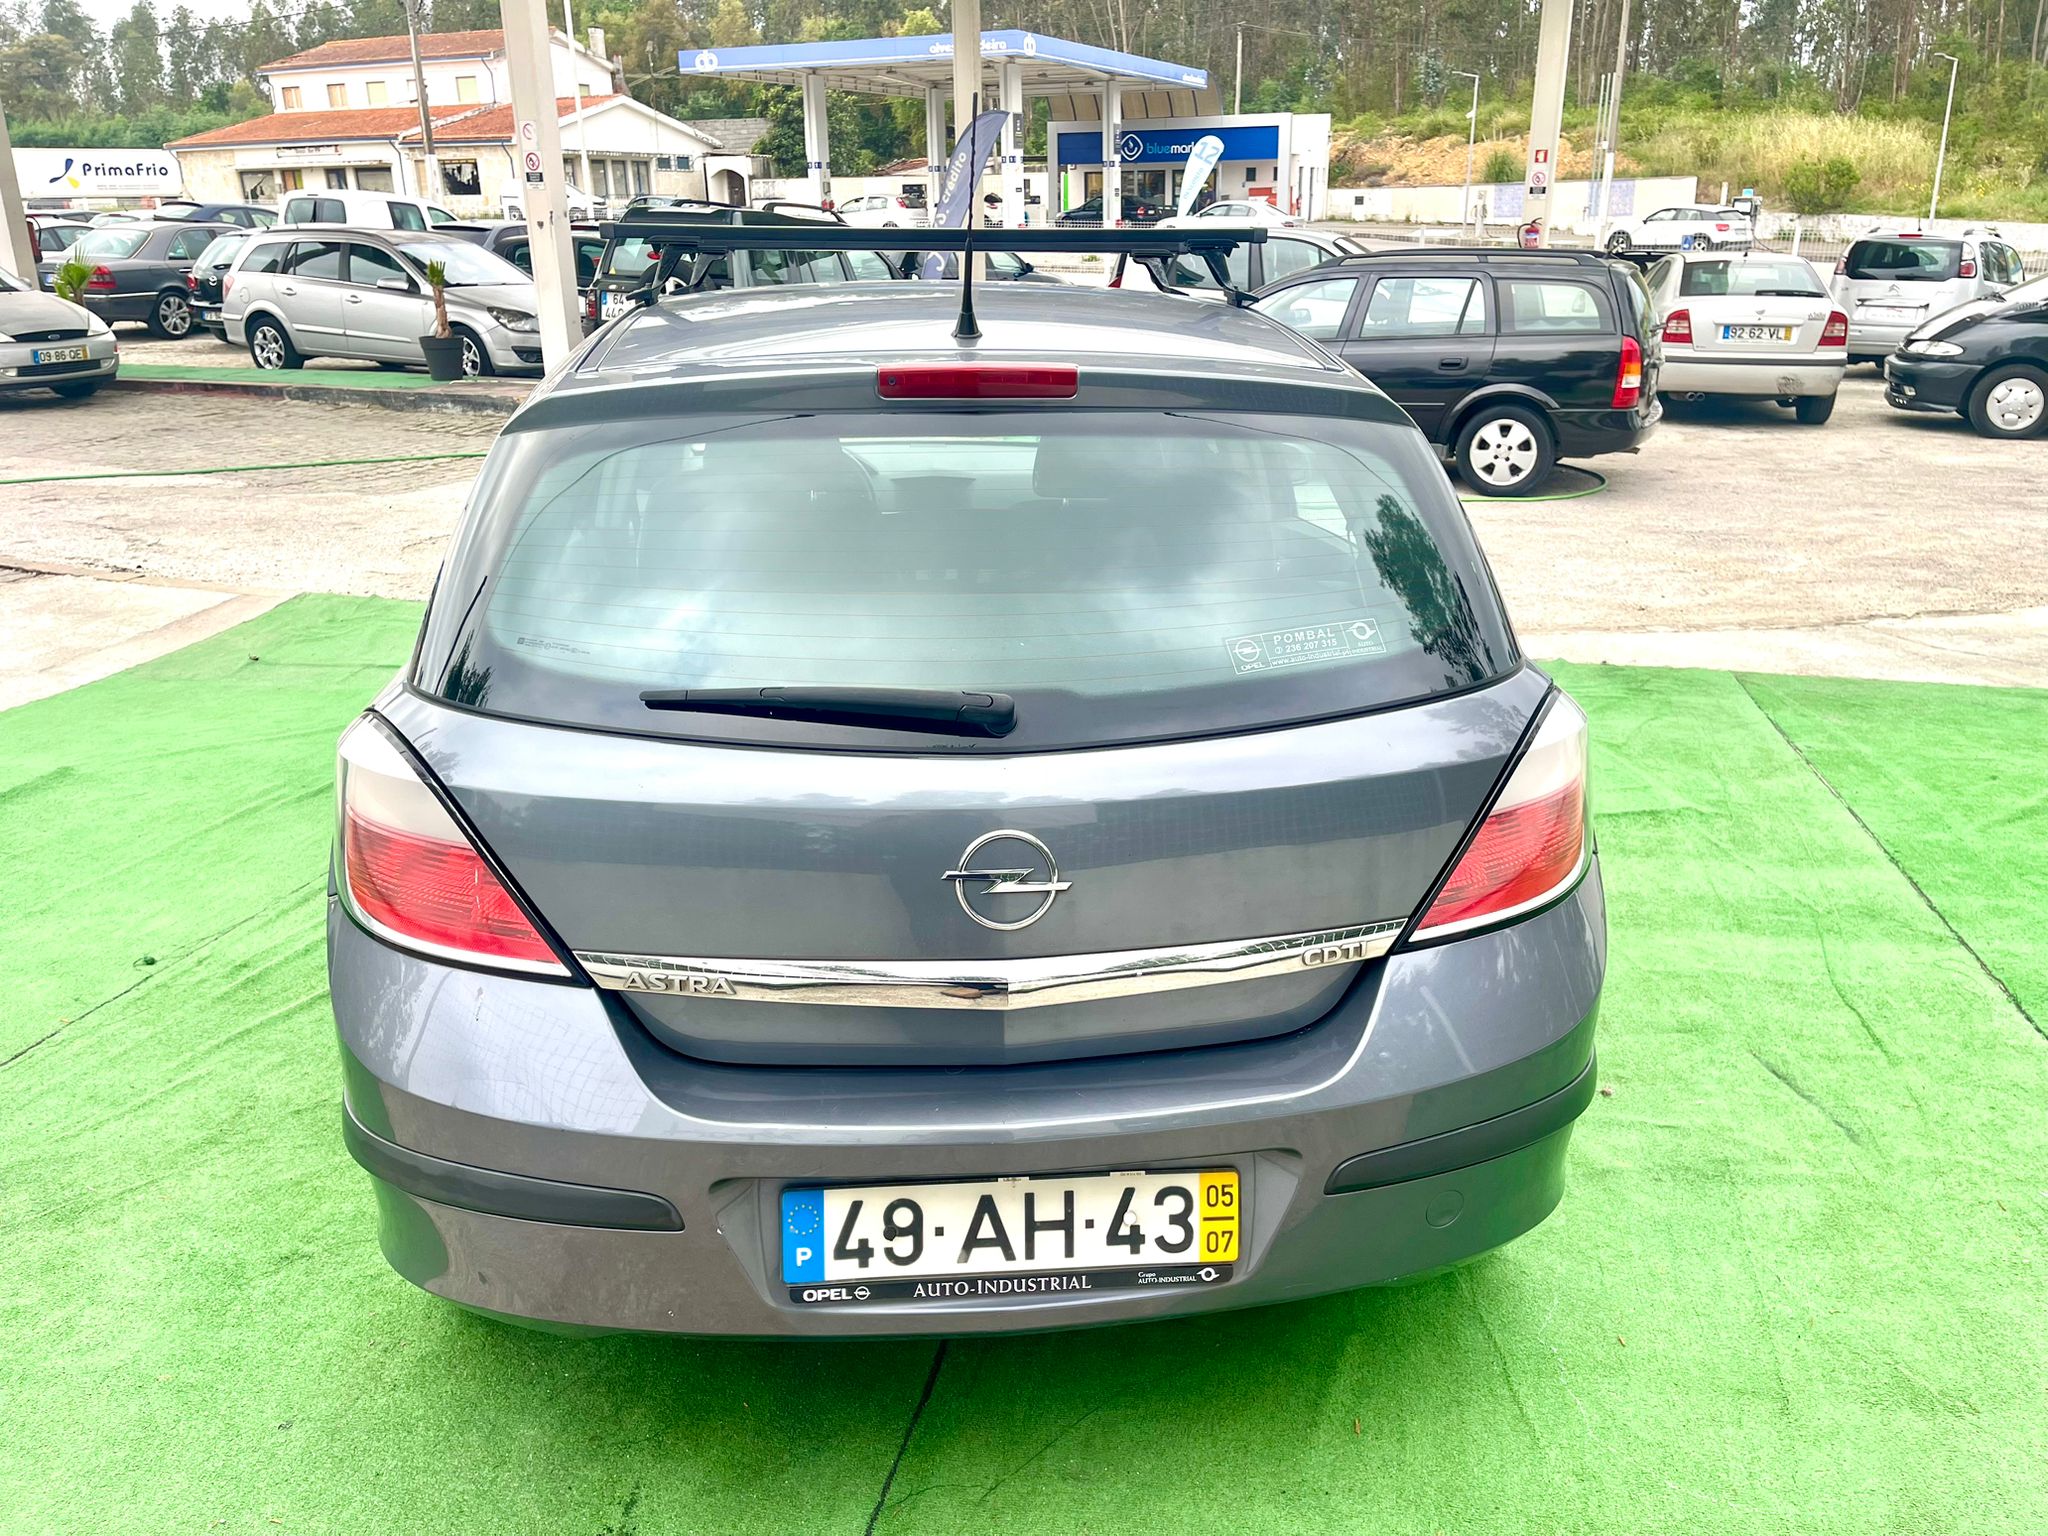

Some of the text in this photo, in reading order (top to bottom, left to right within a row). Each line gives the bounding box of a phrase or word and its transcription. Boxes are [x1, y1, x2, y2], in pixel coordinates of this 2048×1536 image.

[82, 163, 168, 176] PrimaFrio
[1273, 628, 1335, 645] POMBAL
[1285, 638, 1337, 653] 236 207 315
[1241, 661, 1265, 671] OPEL
[624, 972, 737, 995] ASTRA
[1206, 1184, 1234, 1208] 05
[1206, 1230, 1234, 1253] 07
[796, 1247, 812, 1267] P
[802, 1288, 852, 1302] OPEL
[913, 1275, 1092, 1298] AUTO-INDUSTRIAL
